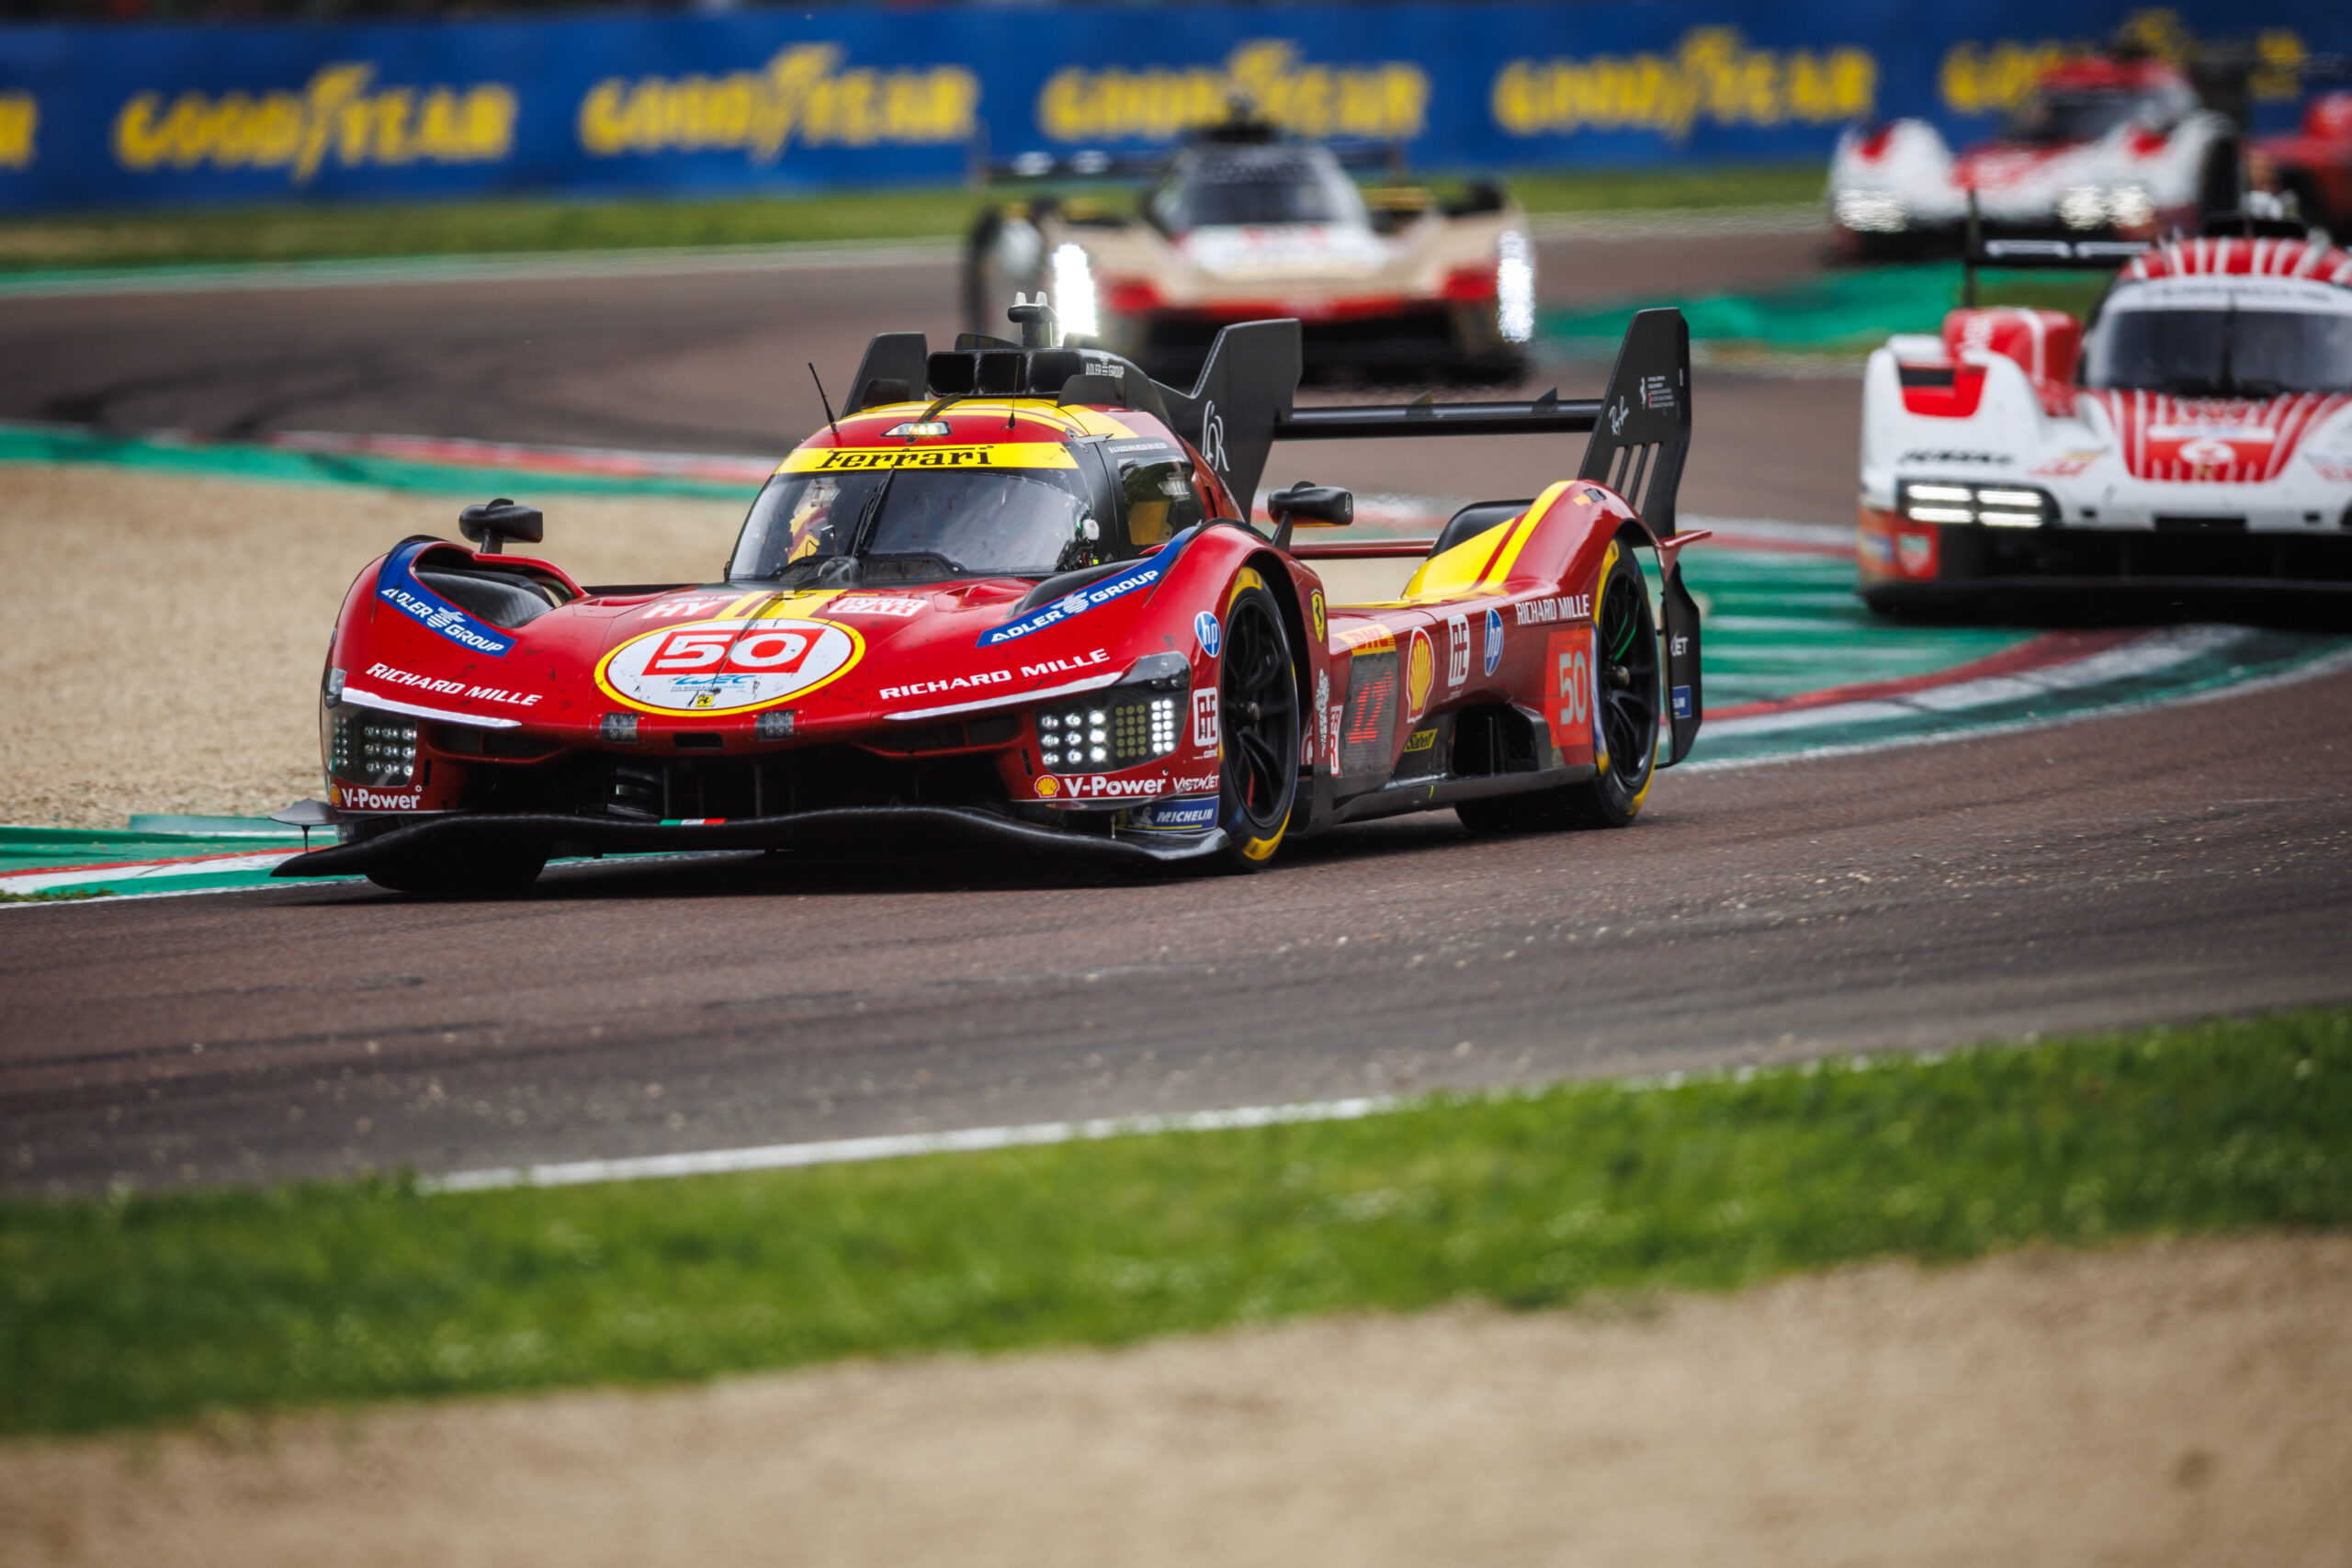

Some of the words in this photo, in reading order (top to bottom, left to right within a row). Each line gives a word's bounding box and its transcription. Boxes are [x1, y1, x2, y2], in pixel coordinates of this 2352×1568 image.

[116, 62, 514, 185] GOODYEAR
[580, 45, 978, 162] GOODYEAR
[815, 446, 994, 469] Ferrari
[381, 587, 434, 618] ADLER
[445, 624, 504, 651] GROUP
[642, 601, 703, 619] HY
[835, 604, 914, 615] CAR
[990, 610, 1064, 642] ADLER
[1090, 570, 1159, 603] GROUP
[1515, 599, 1557, 625] RICHARD
[1558, 594, 1590, 619] MILLE
[655, 633, 807, 669] 50
[1198, 613, 1218, 657] hp
[1486, 609, 1501, 675] hp
[366, 662, 466, 694] RICHARD
[464, 685, 543, 706] MILLE
[675, 674, 756, 684] WEC
[879, 670, 1012, 700] RICHARD
[1020, 649, 1110, 677] MILLE
[1559, 650, 1588, 725] 50
[342, 788, 421, 809] V-Power
[1064, 776, 1166, 797] V-Power
[1157, 808, 1214, 823] MICHELIN
